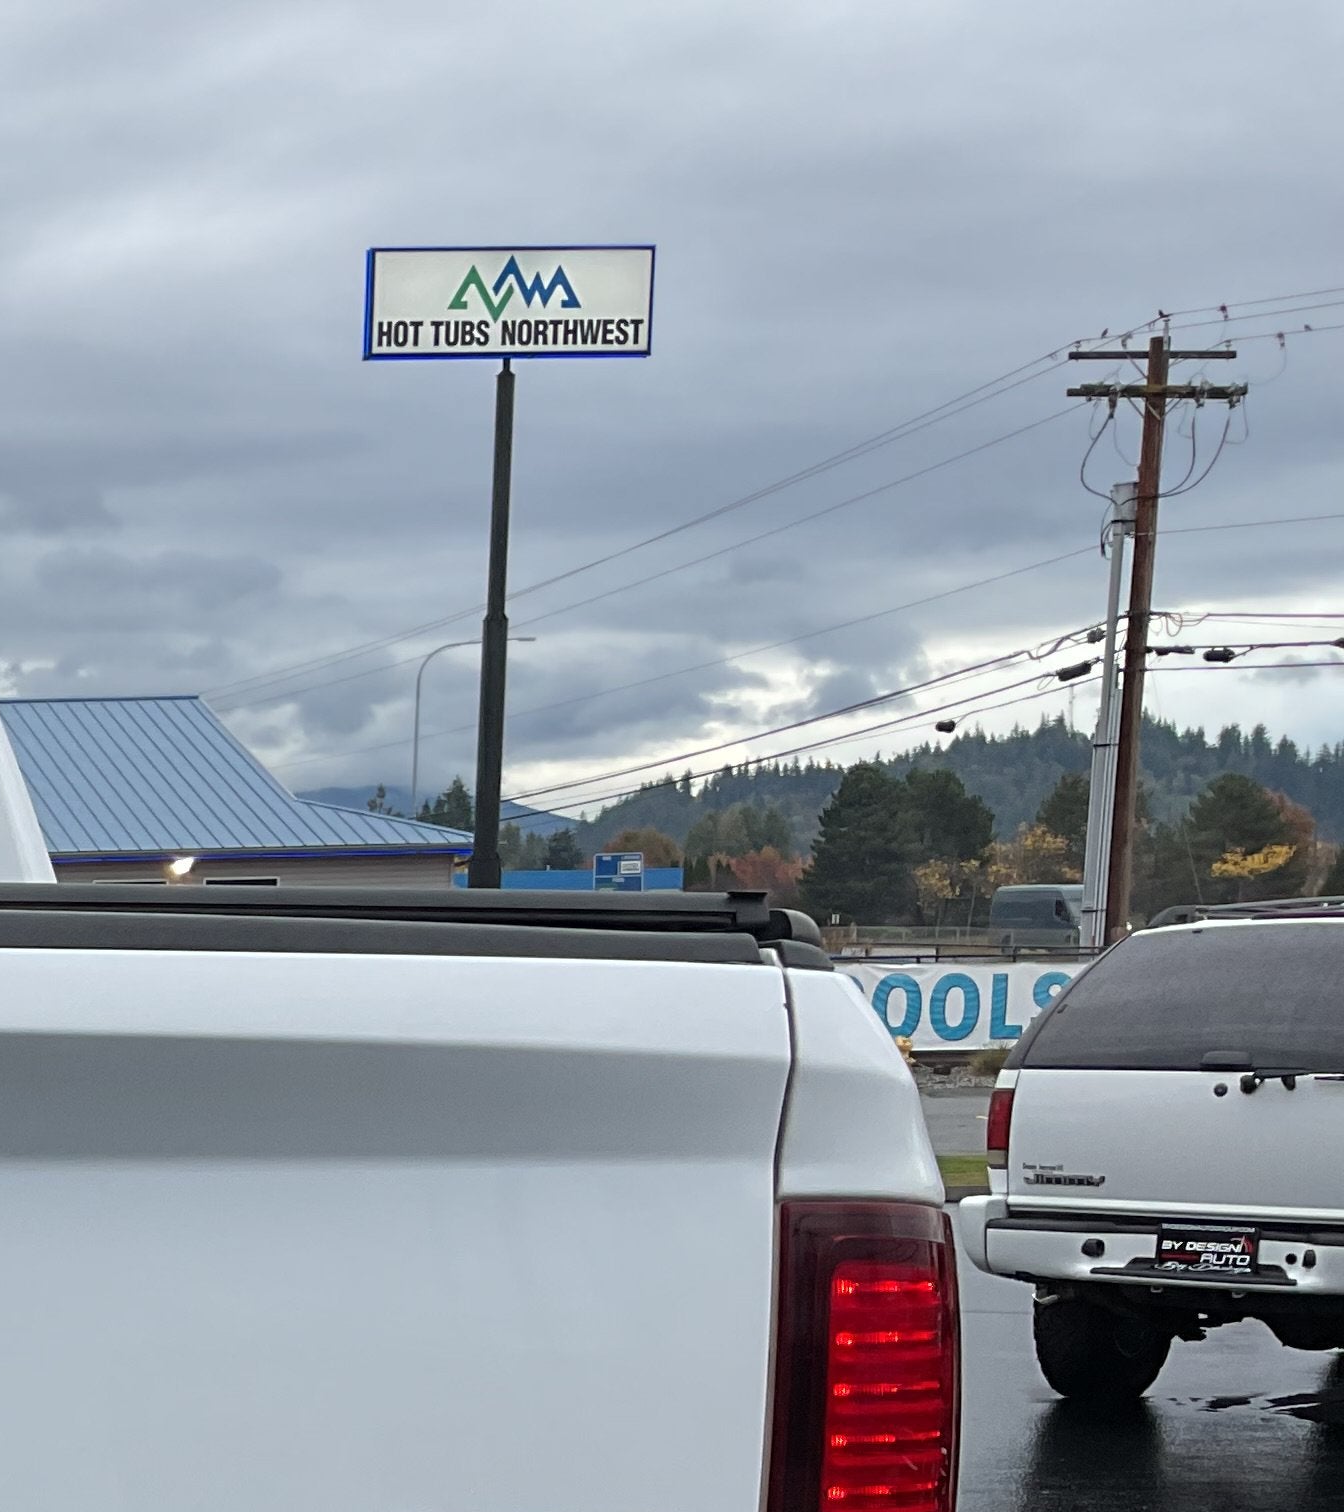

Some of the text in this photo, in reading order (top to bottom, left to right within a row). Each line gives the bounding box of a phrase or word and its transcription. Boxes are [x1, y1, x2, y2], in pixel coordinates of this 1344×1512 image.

[377, 319, 644, 347] HOT TUBS NORTHWEST
[850, 972, 1074, 1041] OOL
[1161, 1240, 1242, 1253] BY DESIGN
[1200, 1253, 1250, 1266] AUTO
